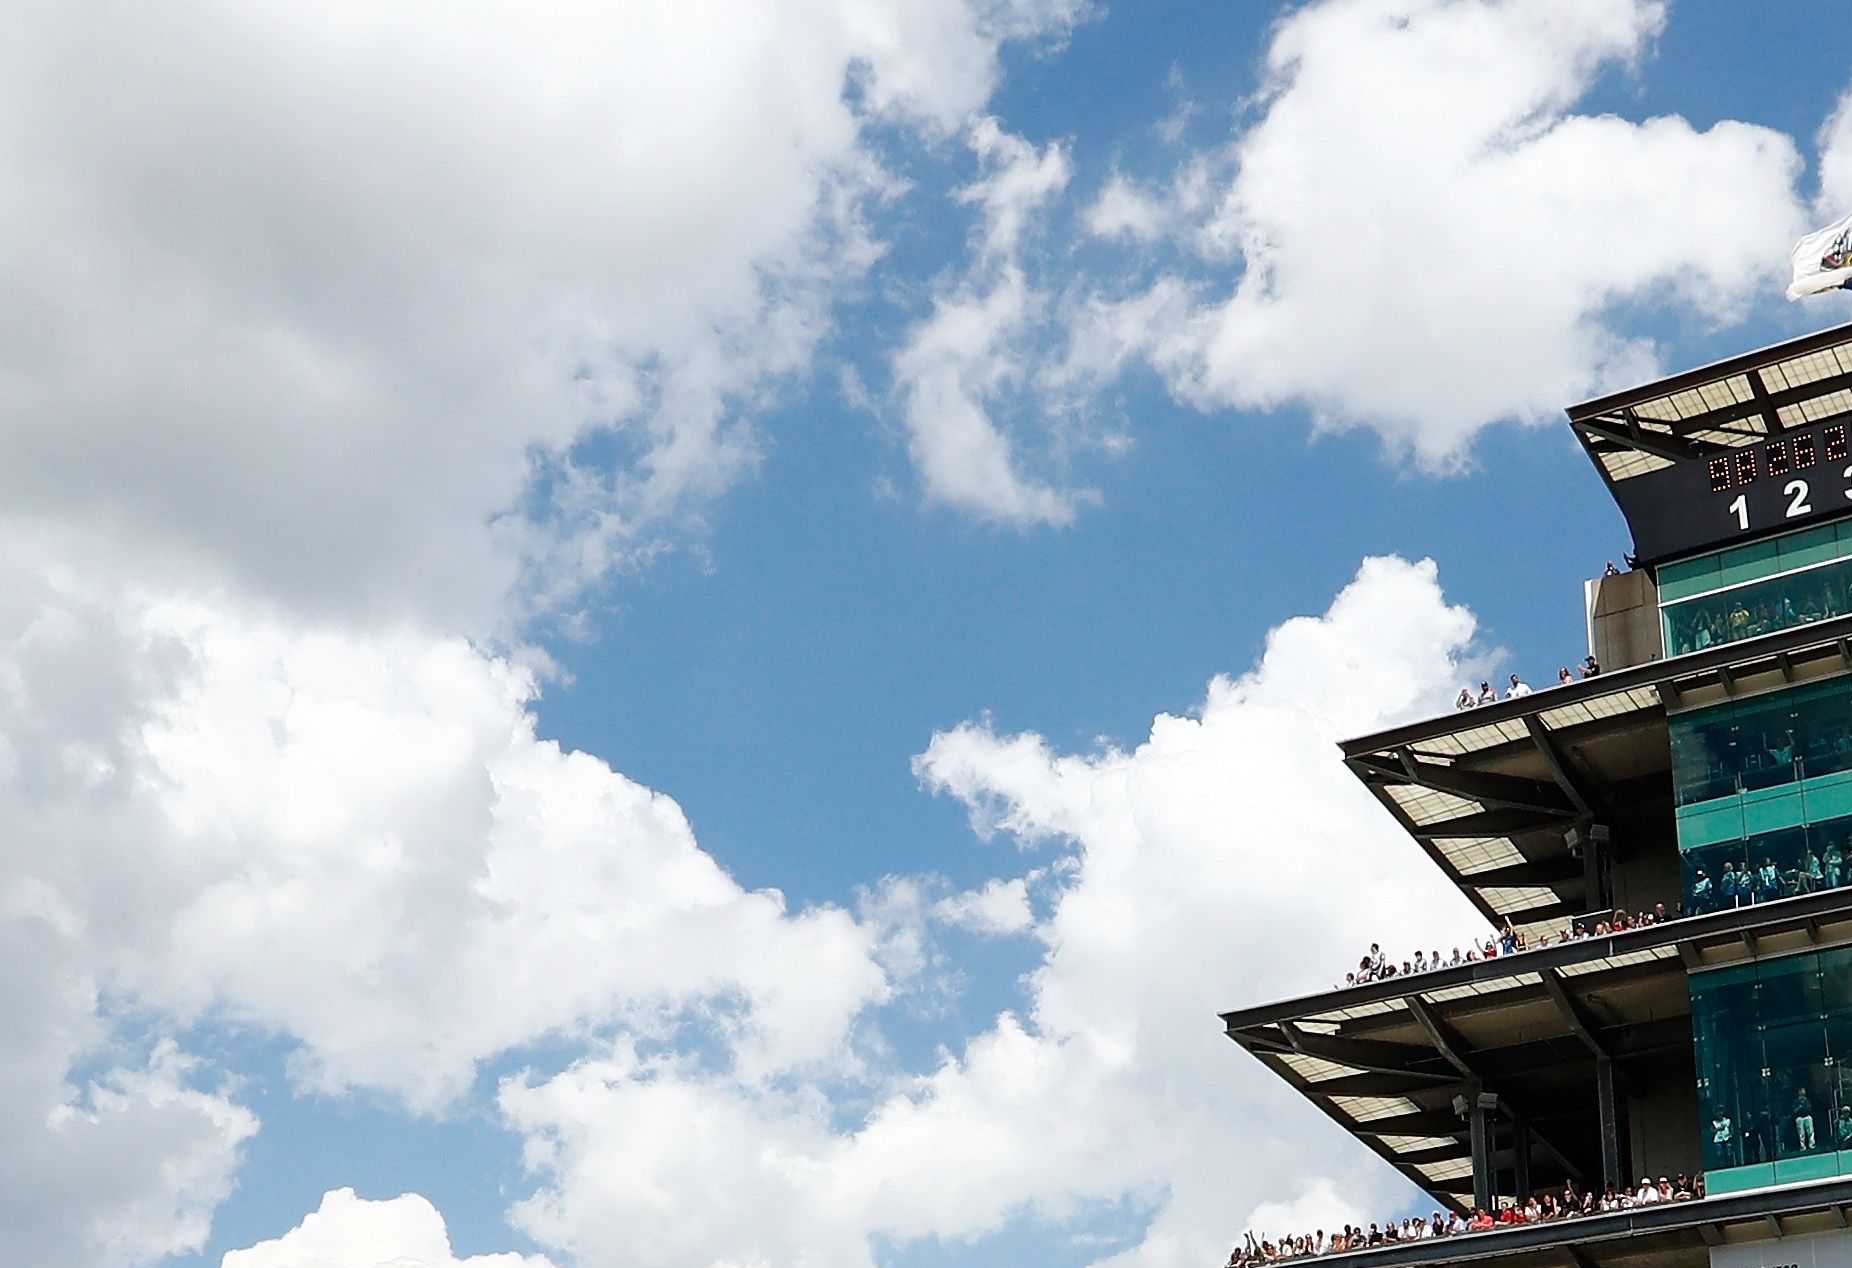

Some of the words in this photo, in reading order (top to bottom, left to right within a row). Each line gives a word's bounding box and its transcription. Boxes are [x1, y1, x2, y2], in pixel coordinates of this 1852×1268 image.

[1766, 433, 1816, 476] 26
[1729, 495, 1750, 531] 1
[1783, 480, 1812, 519] 2
